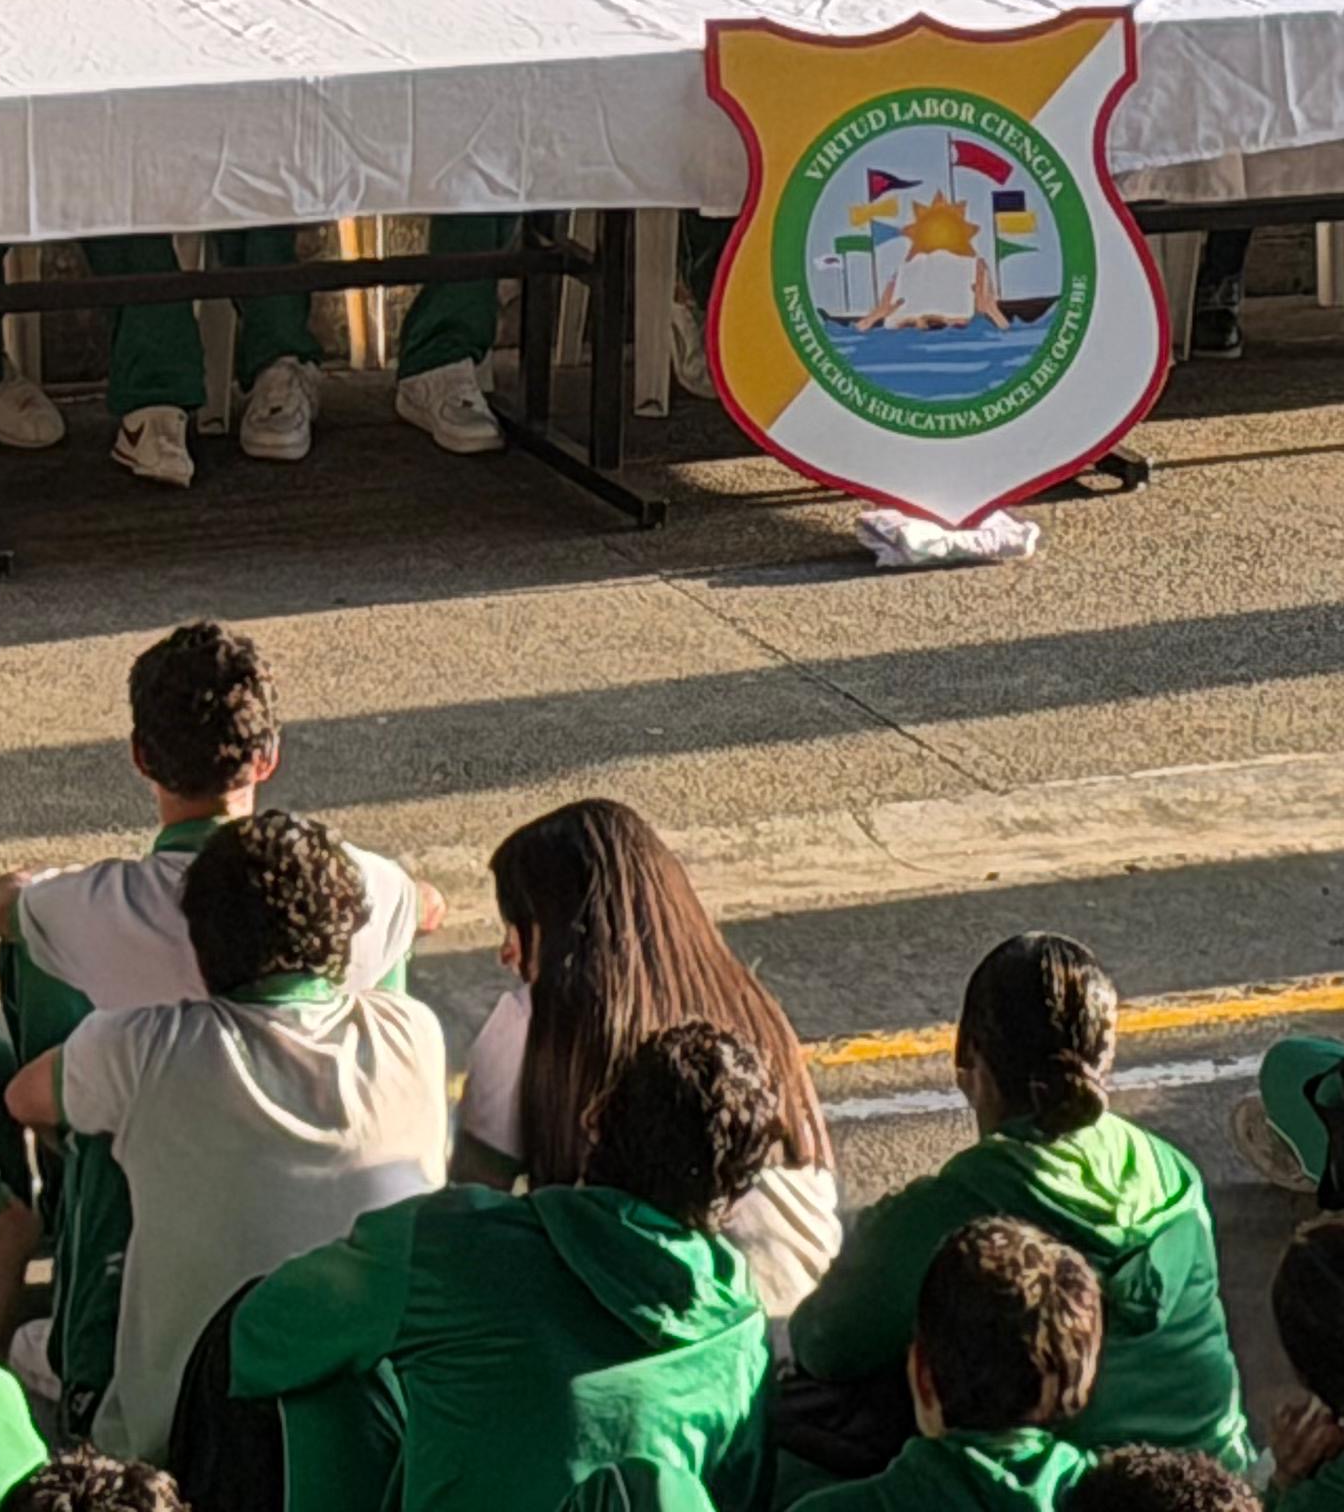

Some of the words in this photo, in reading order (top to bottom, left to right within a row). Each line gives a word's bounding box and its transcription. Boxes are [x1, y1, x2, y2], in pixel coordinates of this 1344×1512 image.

[804, 108, 887, 181] VIRTUD
[889, 97, 976, 125] LABOR
[979, 111, 1064, 199] CIENCIA
[866, 395, 982, 431] EDUCATIVA
[981, 380, 1036, 423] DOCE
[1030, 355, 1059, 388] DE
